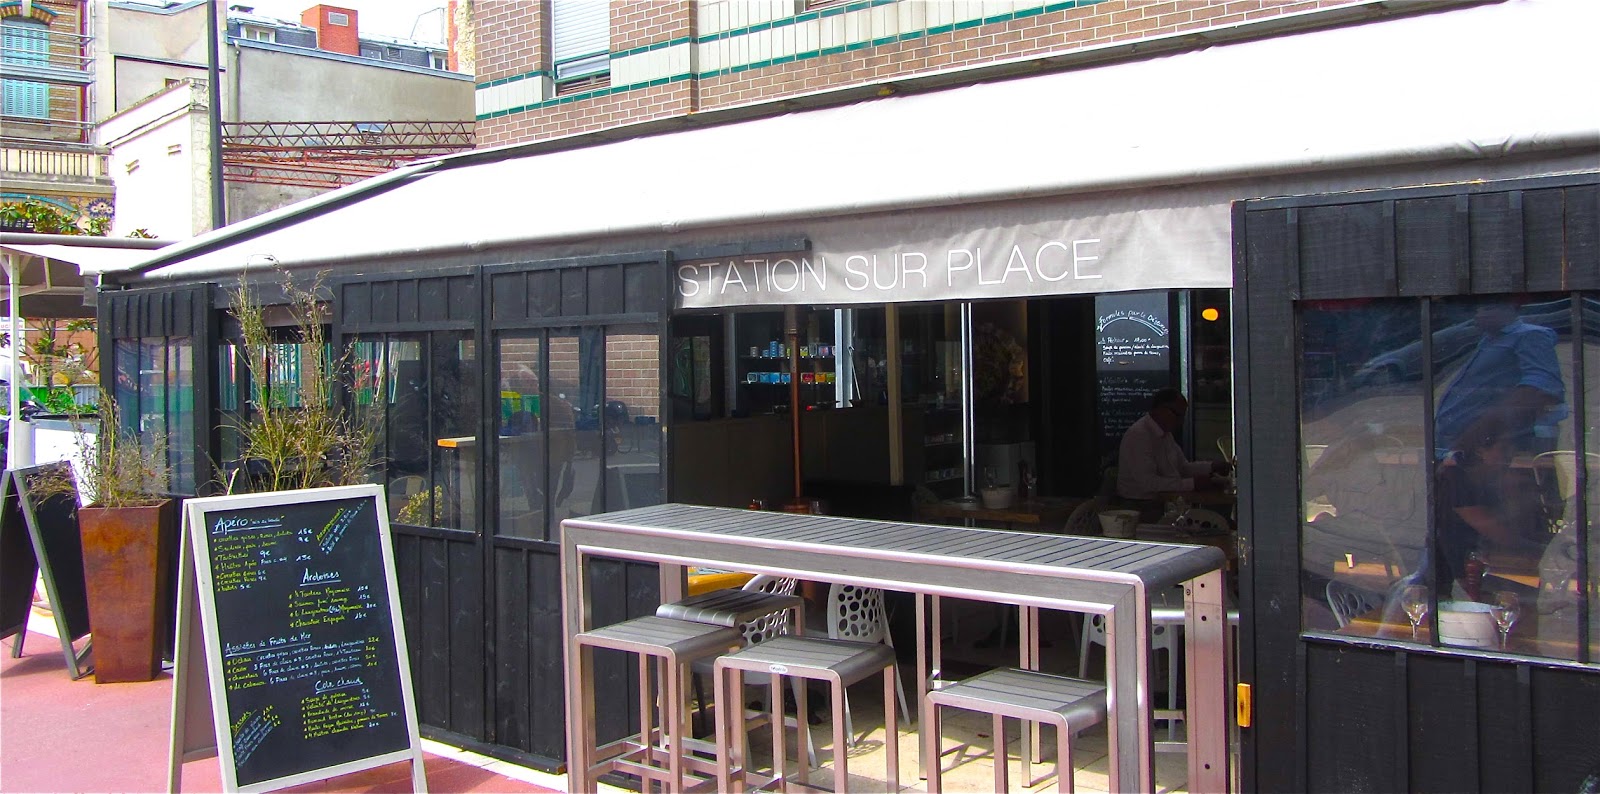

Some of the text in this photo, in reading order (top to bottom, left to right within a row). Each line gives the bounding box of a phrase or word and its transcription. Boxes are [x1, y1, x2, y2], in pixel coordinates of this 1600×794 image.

[678, 238, 1103, 297] STATION SUR PLACE
[214, 516, 249, 536] Apéro
